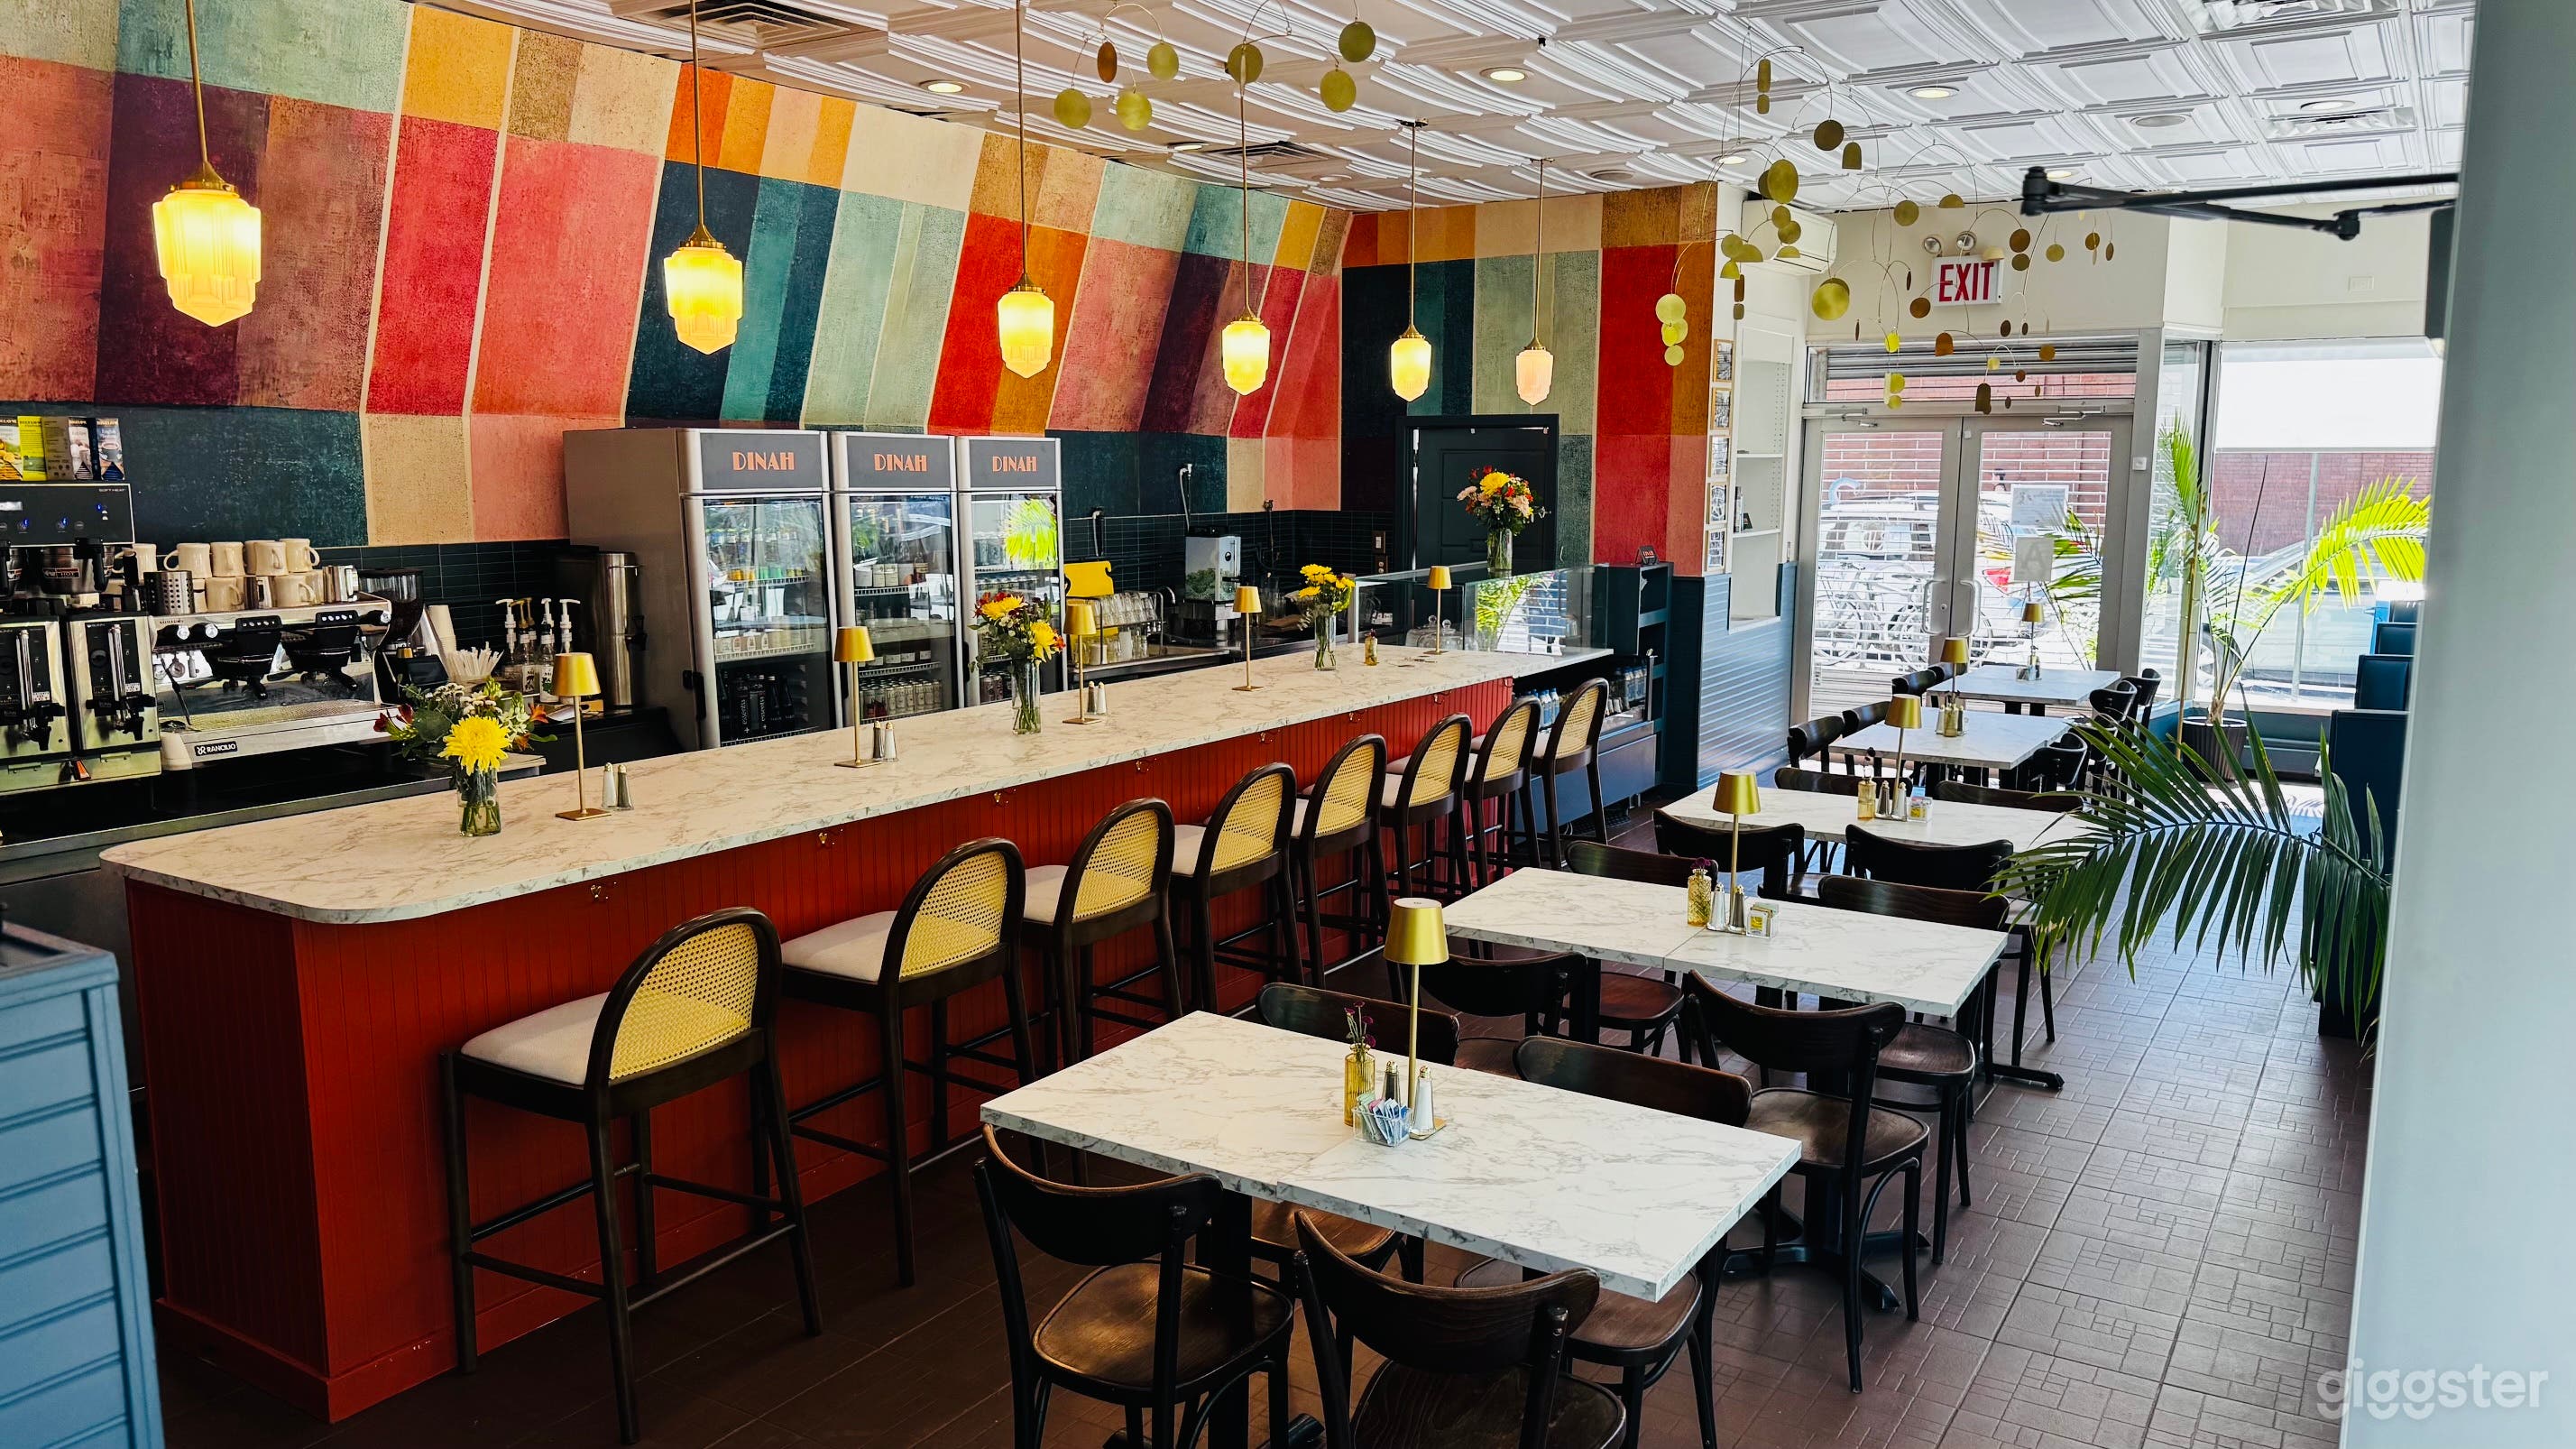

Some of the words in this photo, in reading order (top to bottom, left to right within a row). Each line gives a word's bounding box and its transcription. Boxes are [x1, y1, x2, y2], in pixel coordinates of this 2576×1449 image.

[1939, 262, 1994, 302] EXIT
[732, 451, 795, 471] DINAH
[874, 453, 927, 473] DINAH
[992, 456, 1037, 473] DINAH
[207, 743, 236, 752] RANCILIO
